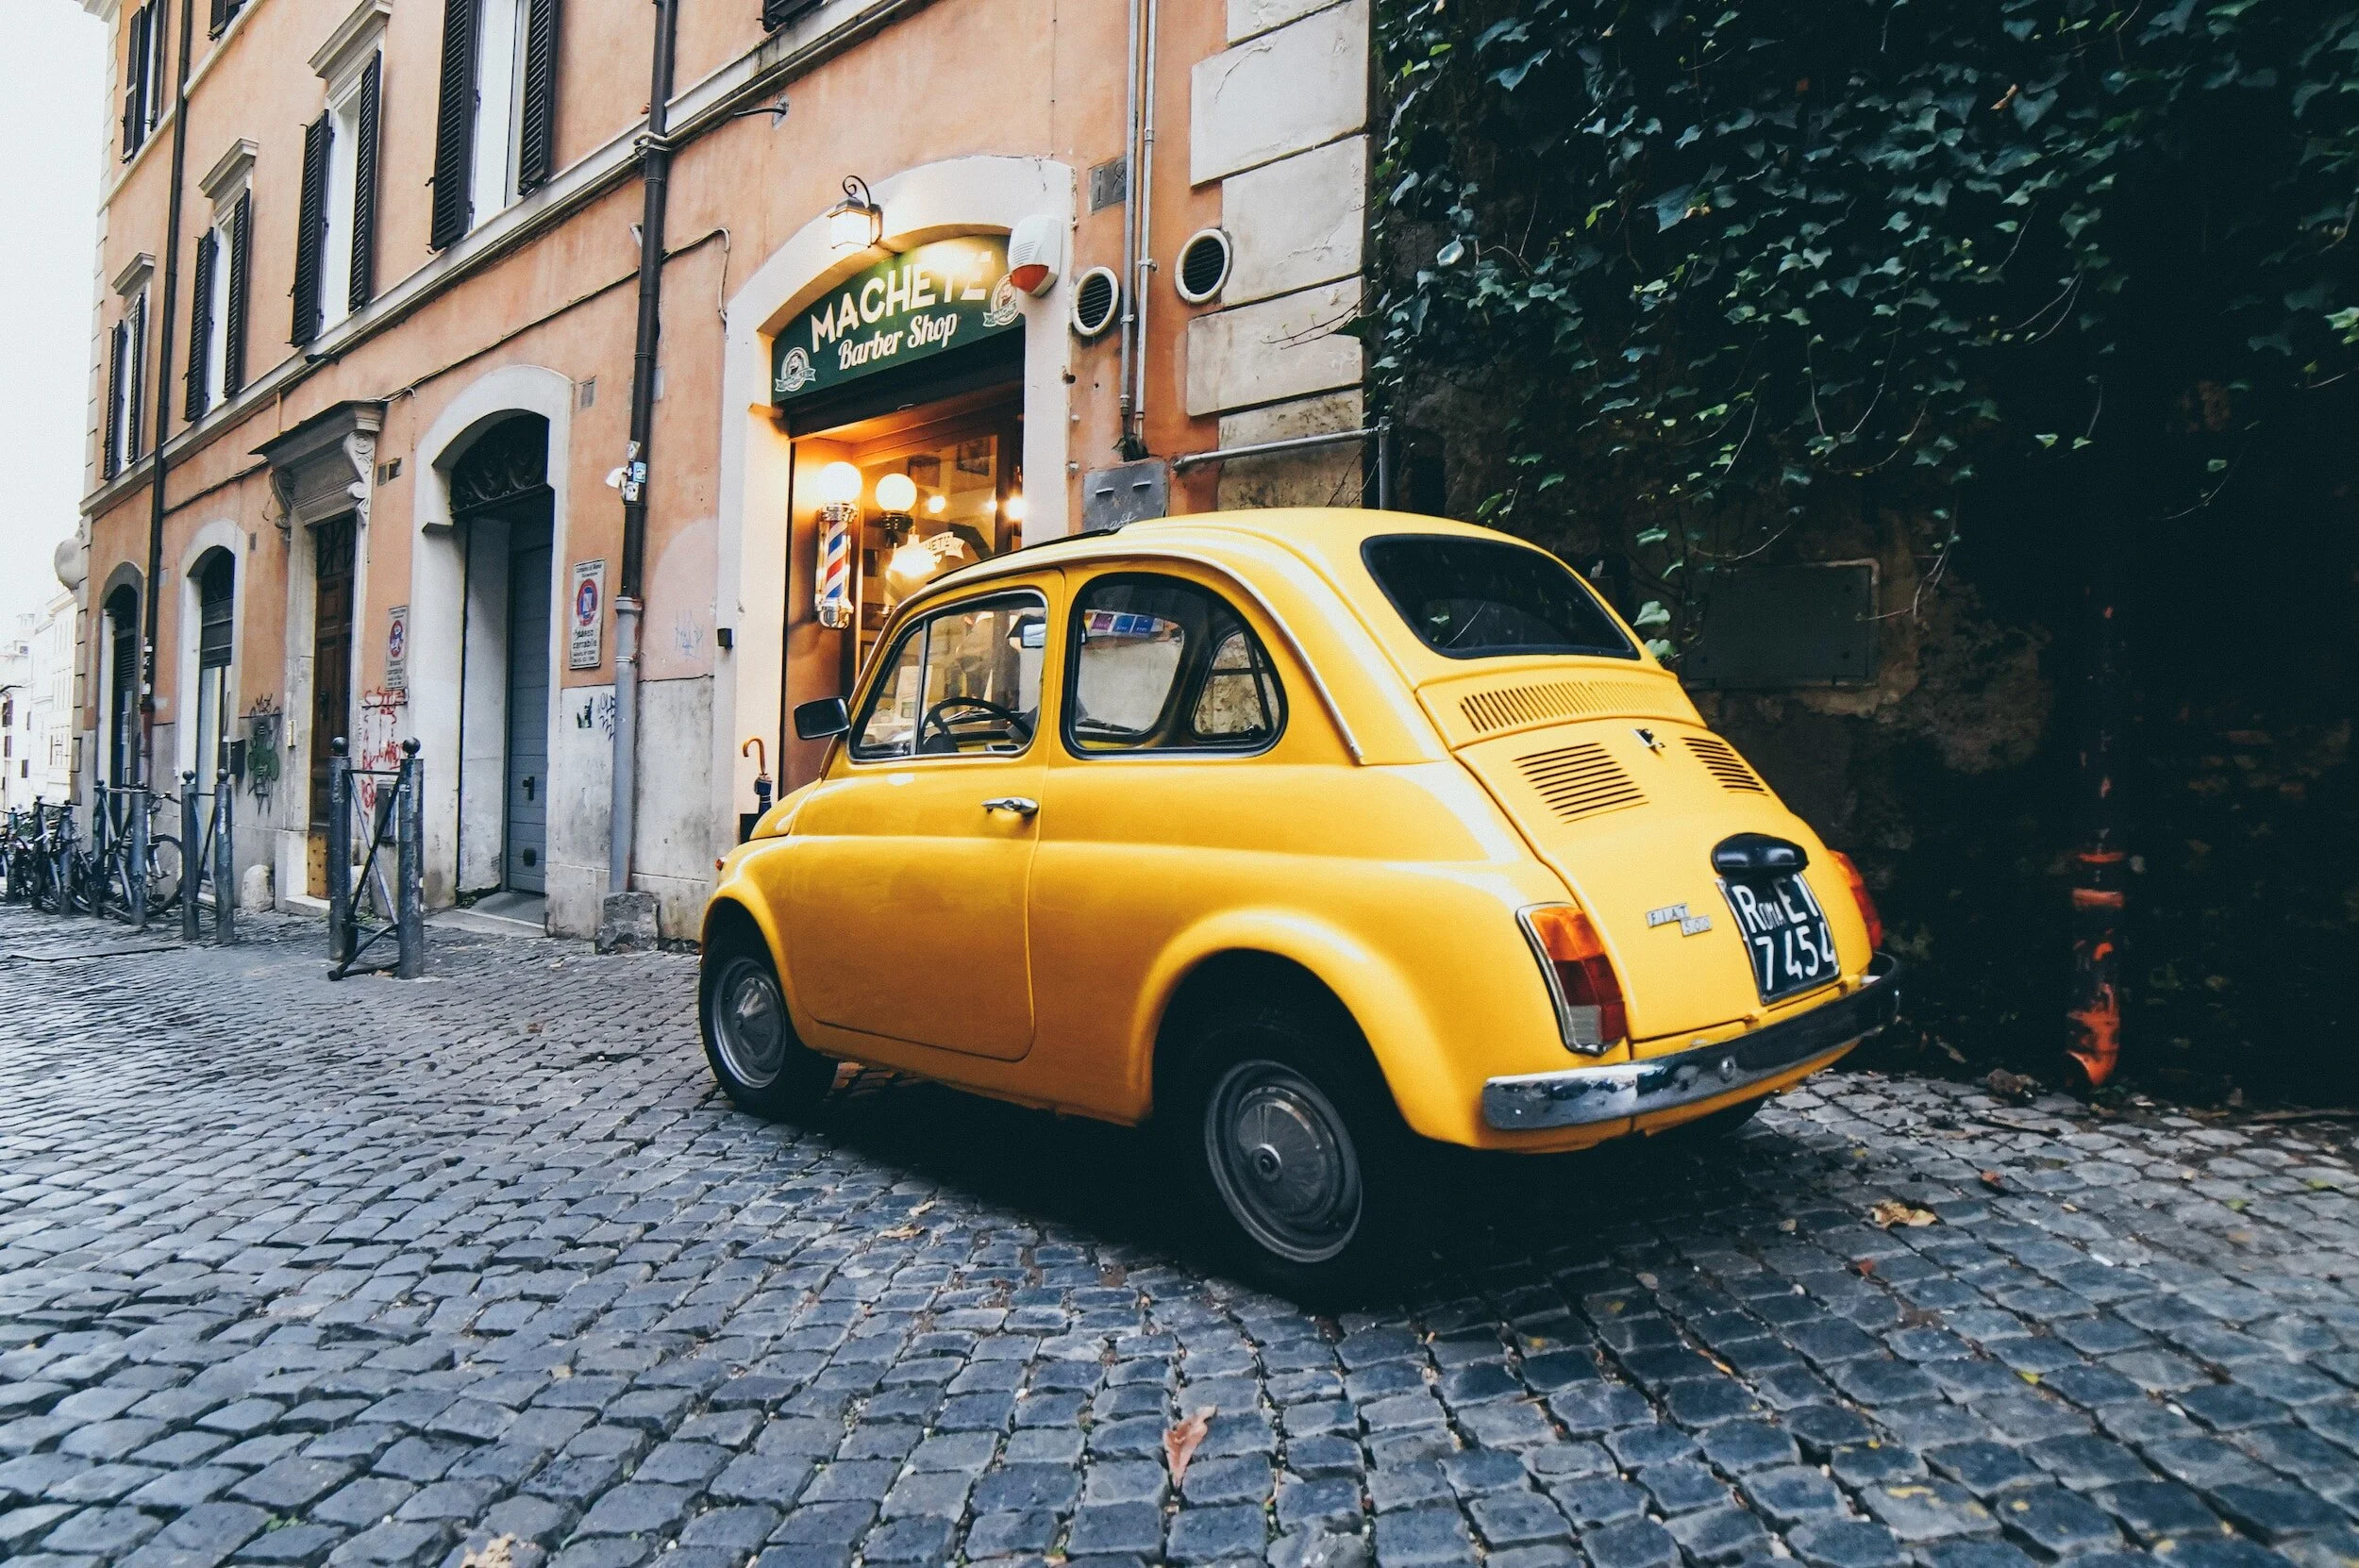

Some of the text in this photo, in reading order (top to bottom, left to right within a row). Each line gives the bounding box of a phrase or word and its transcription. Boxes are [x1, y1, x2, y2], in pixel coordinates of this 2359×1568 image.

[811, 250, 992, 353] MACHETE
[838, 313, 958, 371] Barber Shop
[1649, 905, 1686, 925] FIAT
[1684, 918, 1710, 933] 500
[1755, 921, 1837, 991] 7454
